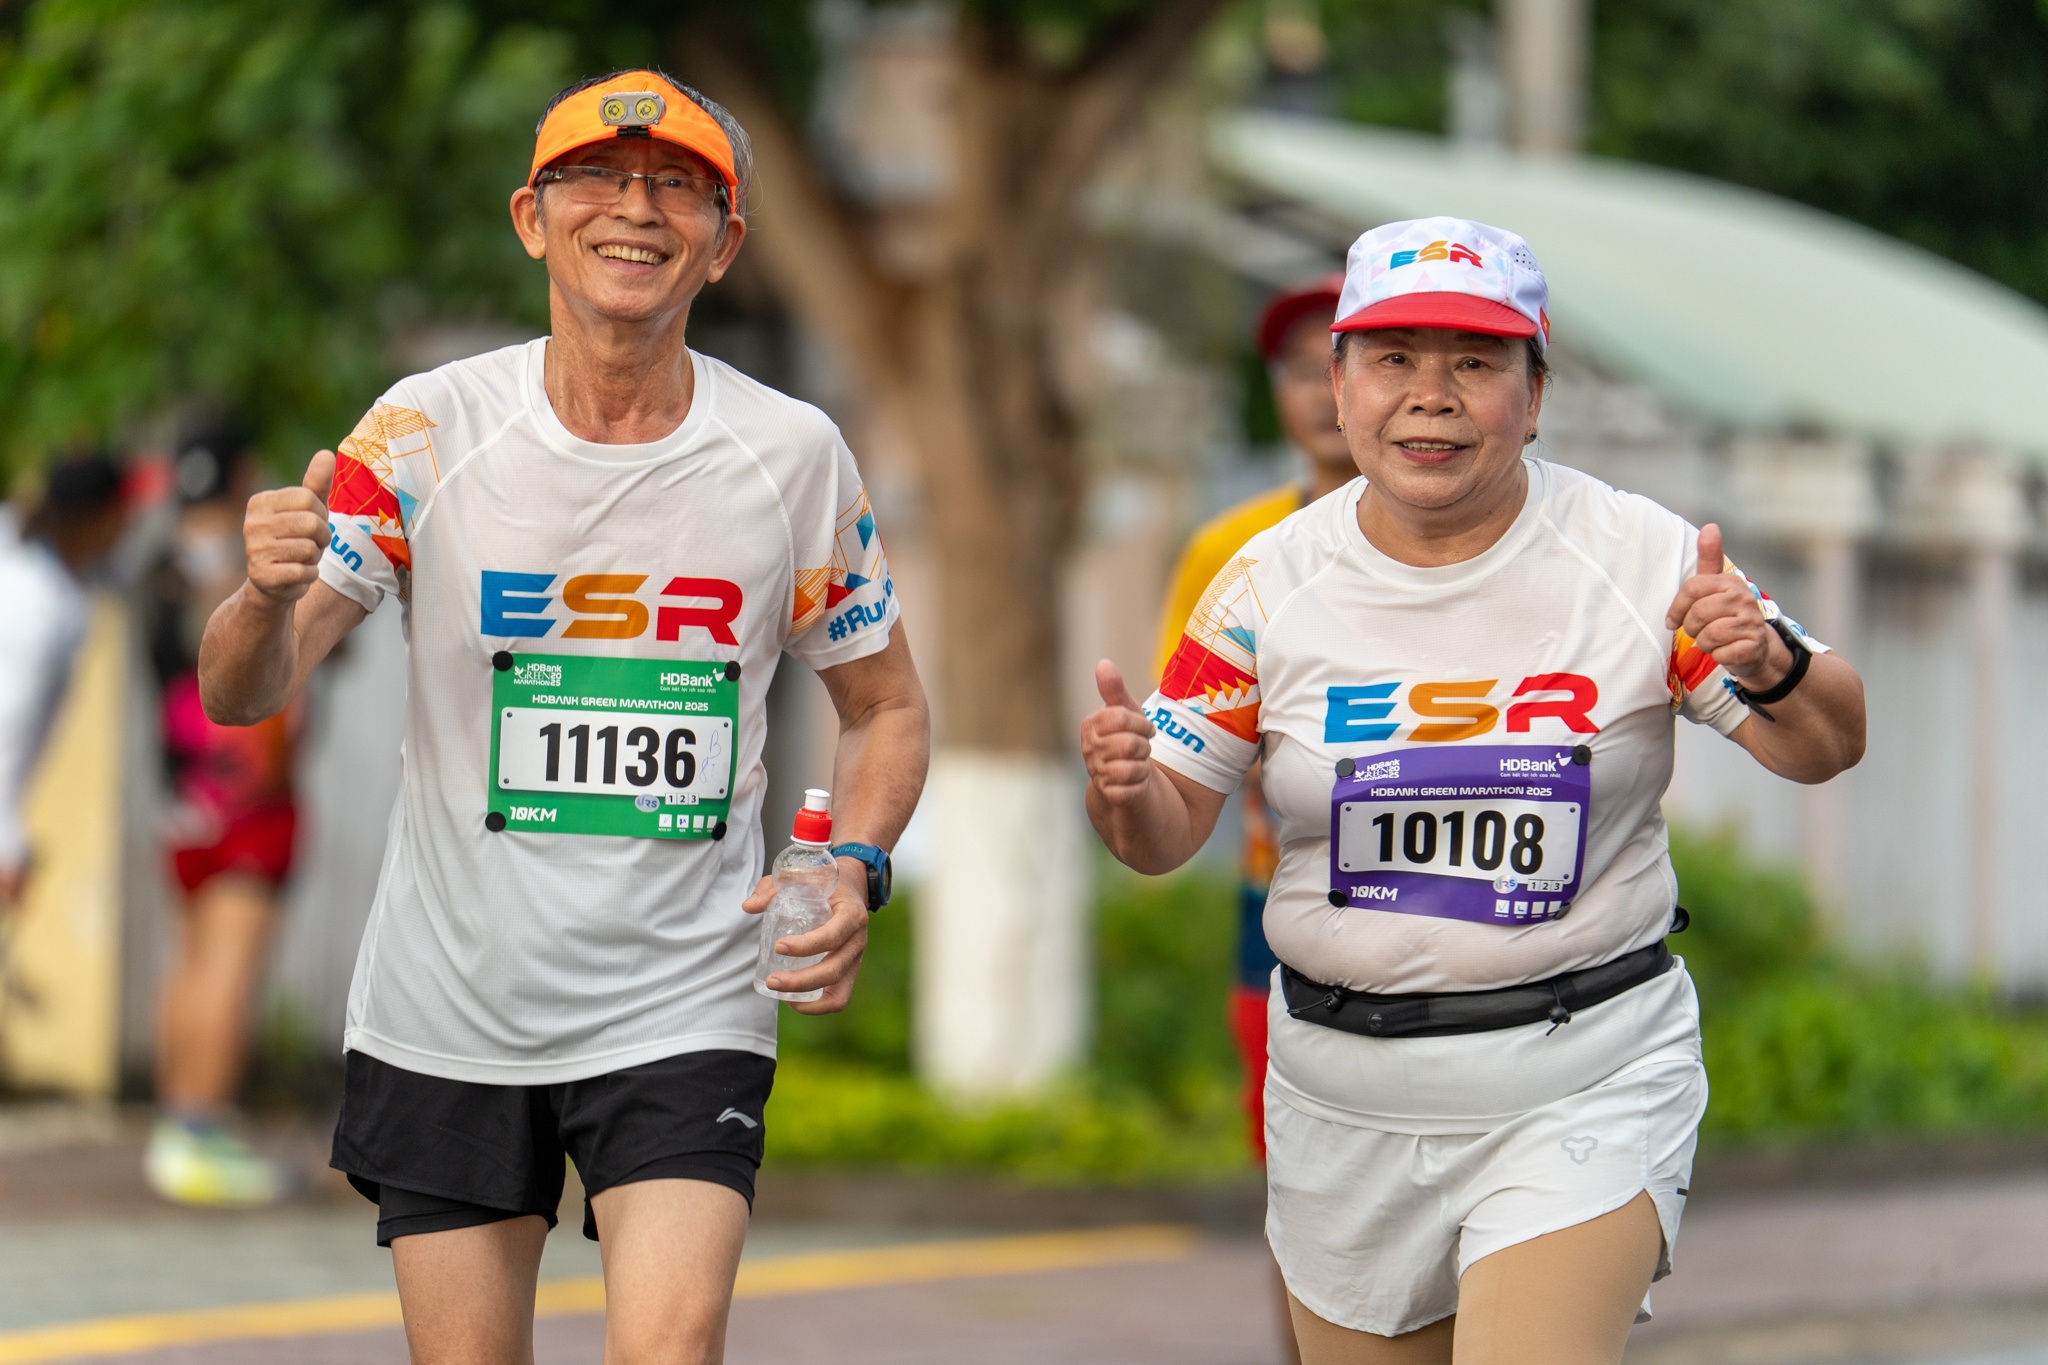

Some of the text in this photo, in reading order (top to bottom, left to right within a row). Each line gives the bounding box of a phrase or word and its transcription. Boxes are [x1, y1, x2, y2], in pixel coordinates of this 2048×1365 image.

[1390, 240, 1484, 270] ESR
[328, 522, 363, 573] un
[480, 570, 743, 646] ESR
[527, 663, 562, 673] HDBank
[513, 679, 550, 687] MARATHON
[660, 672, 713, 687] HDBank
[532, 694, 709, 711] HDBANK GREEN MARATHON 2025
[1324, 672, 1600, 743] ESR
[1142, 707, 1206, 754] Run
[539, 722, 697, 788] 11136
[1500, 759, 1557, 772] HDBank
[680, 795, 686, 803] 2
[691, 795, 697, 803] 3
[1370, 786, 1553, 797] HDBANK GREEN MARATHON 2025
[509, 806, 558, 823] 10KM
[1372, 810, 1545, 875] 10108
[1350, 885, 1398, 901] 10KM
[1542, 882, 1549, 890] 2
[1554, 882, 1560, 890] 3
